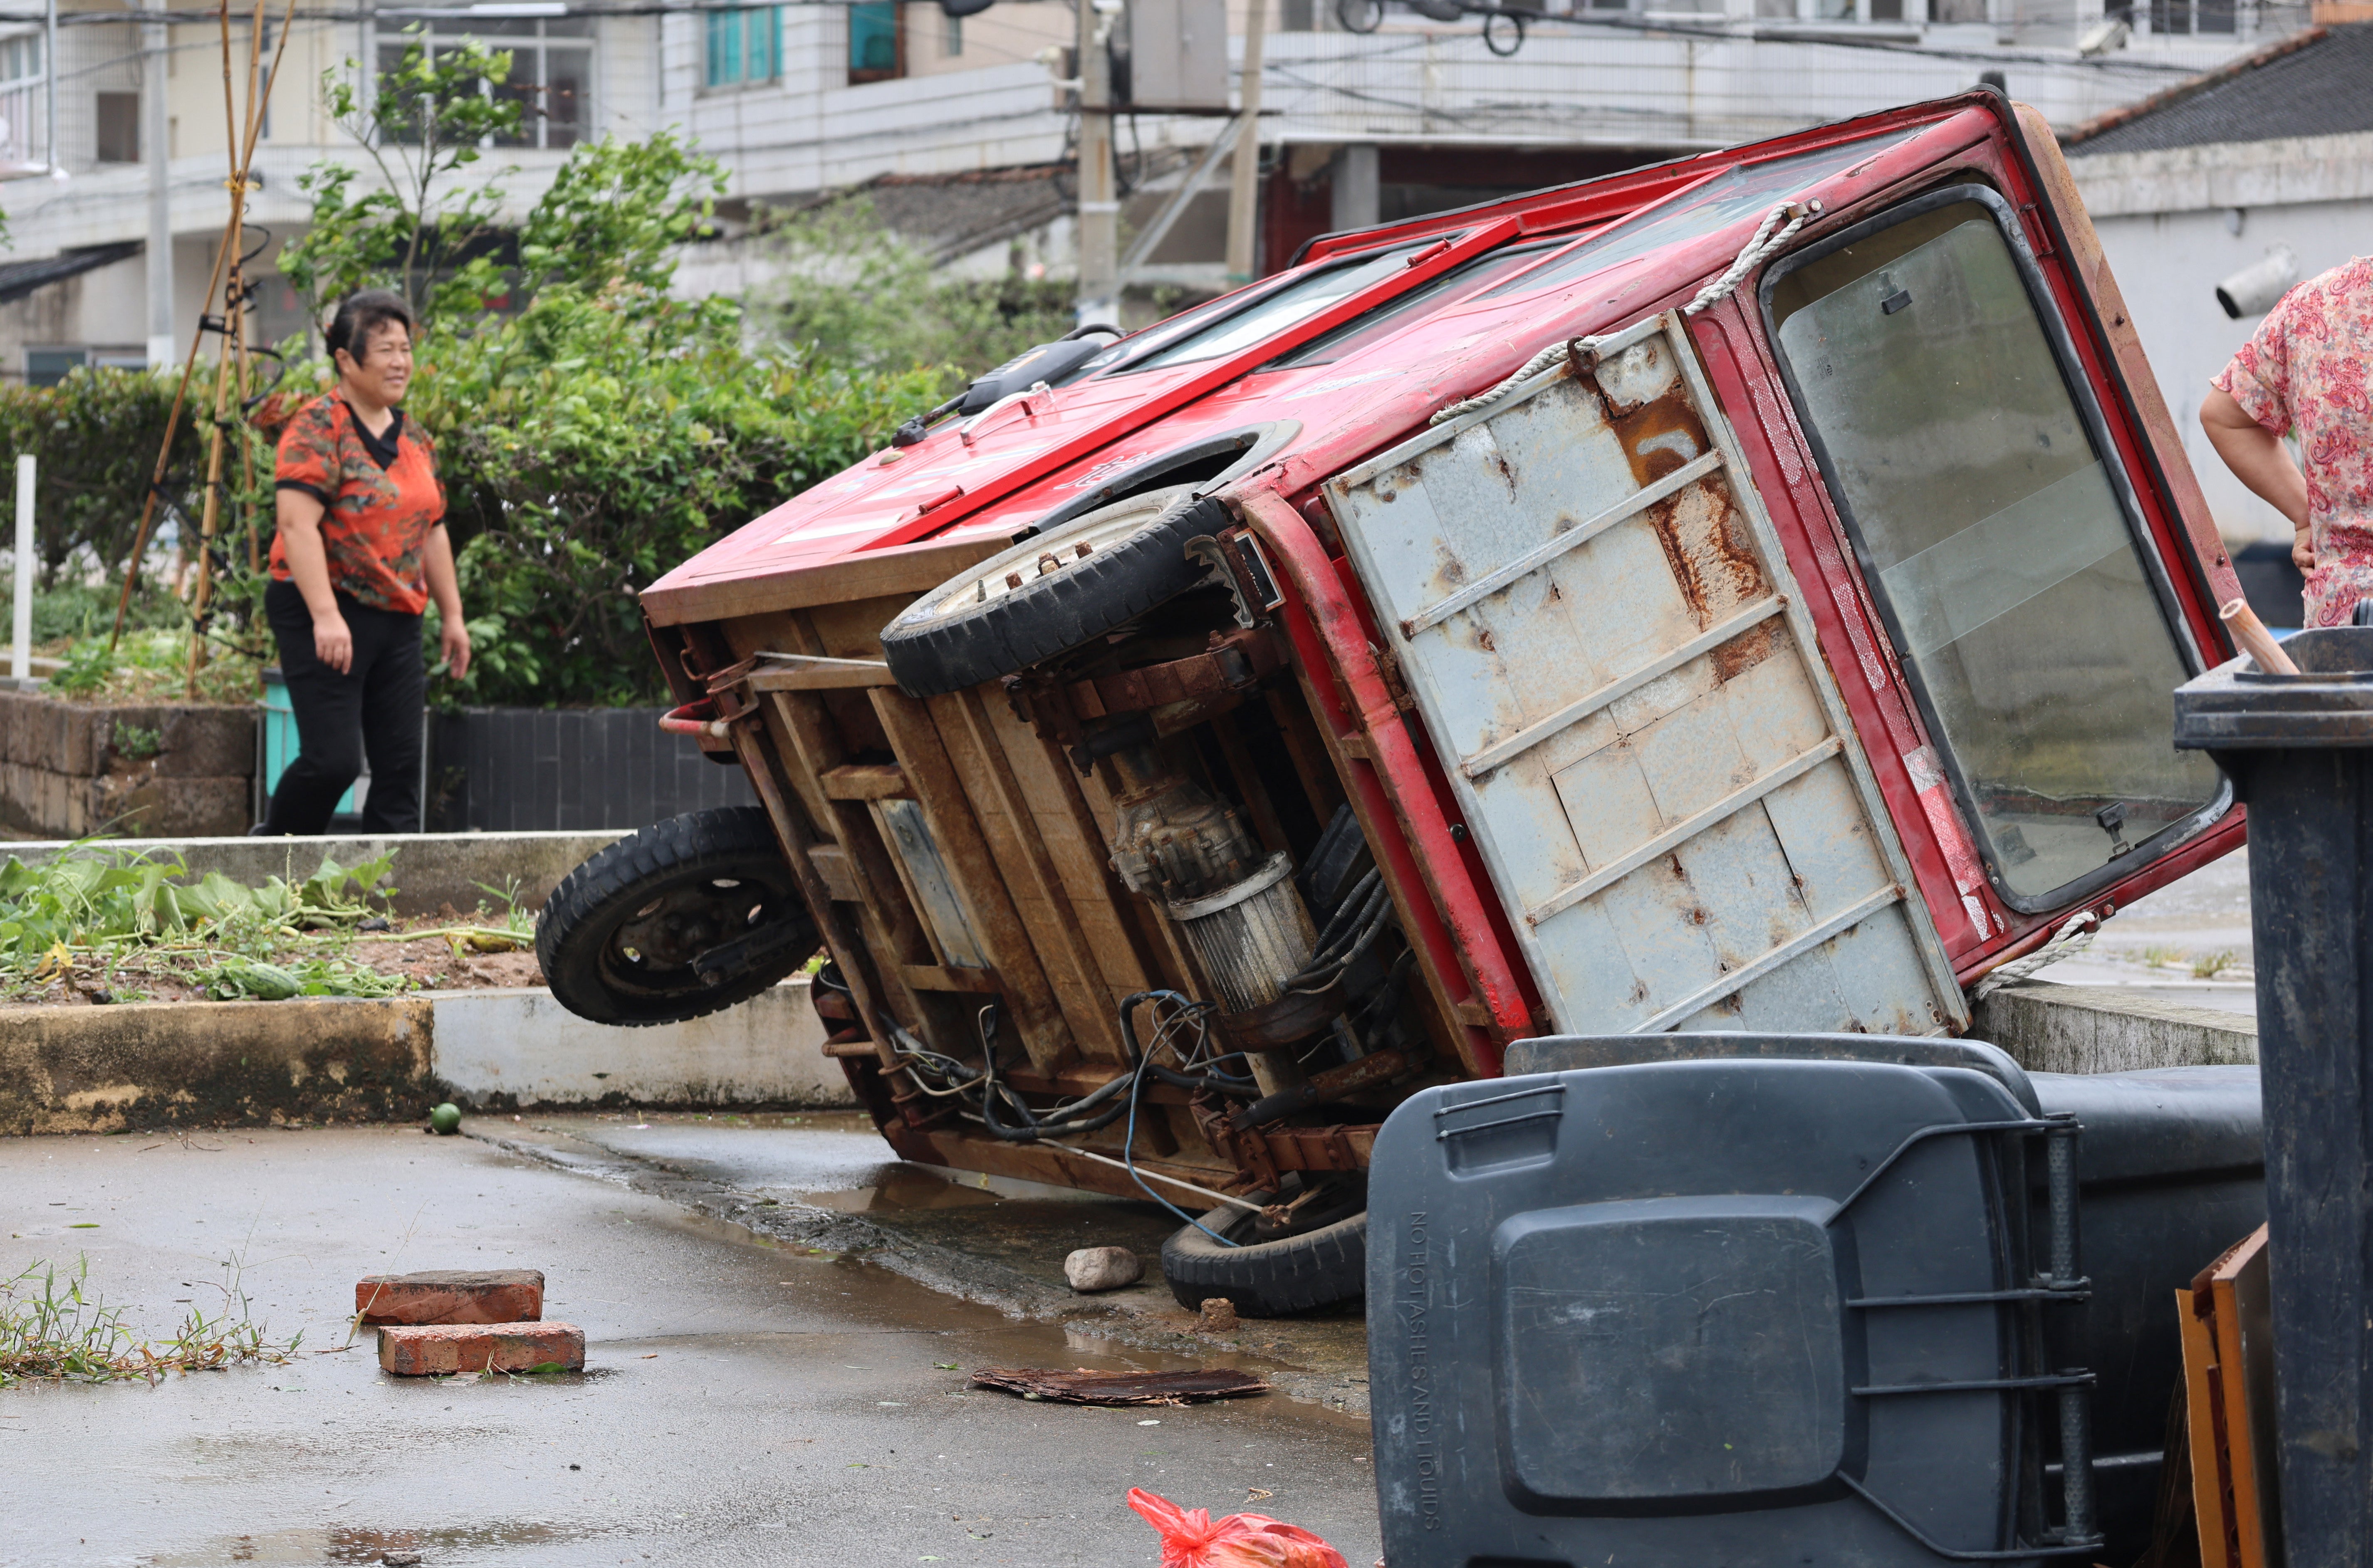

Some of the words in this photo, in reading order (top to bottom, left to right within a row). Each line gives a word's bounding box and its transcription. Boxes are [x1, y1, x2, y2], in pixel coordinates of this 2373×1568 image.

[1411, 1212, 1427, 1244] NO
[1409, 1252, 1426, 1299] HOT
[1409, 1303, 1427, 1380] ASHES
[1413, 1386, 1430, 1433] AND
[1416, 1441, 1440, 1530] LIQUIDS
